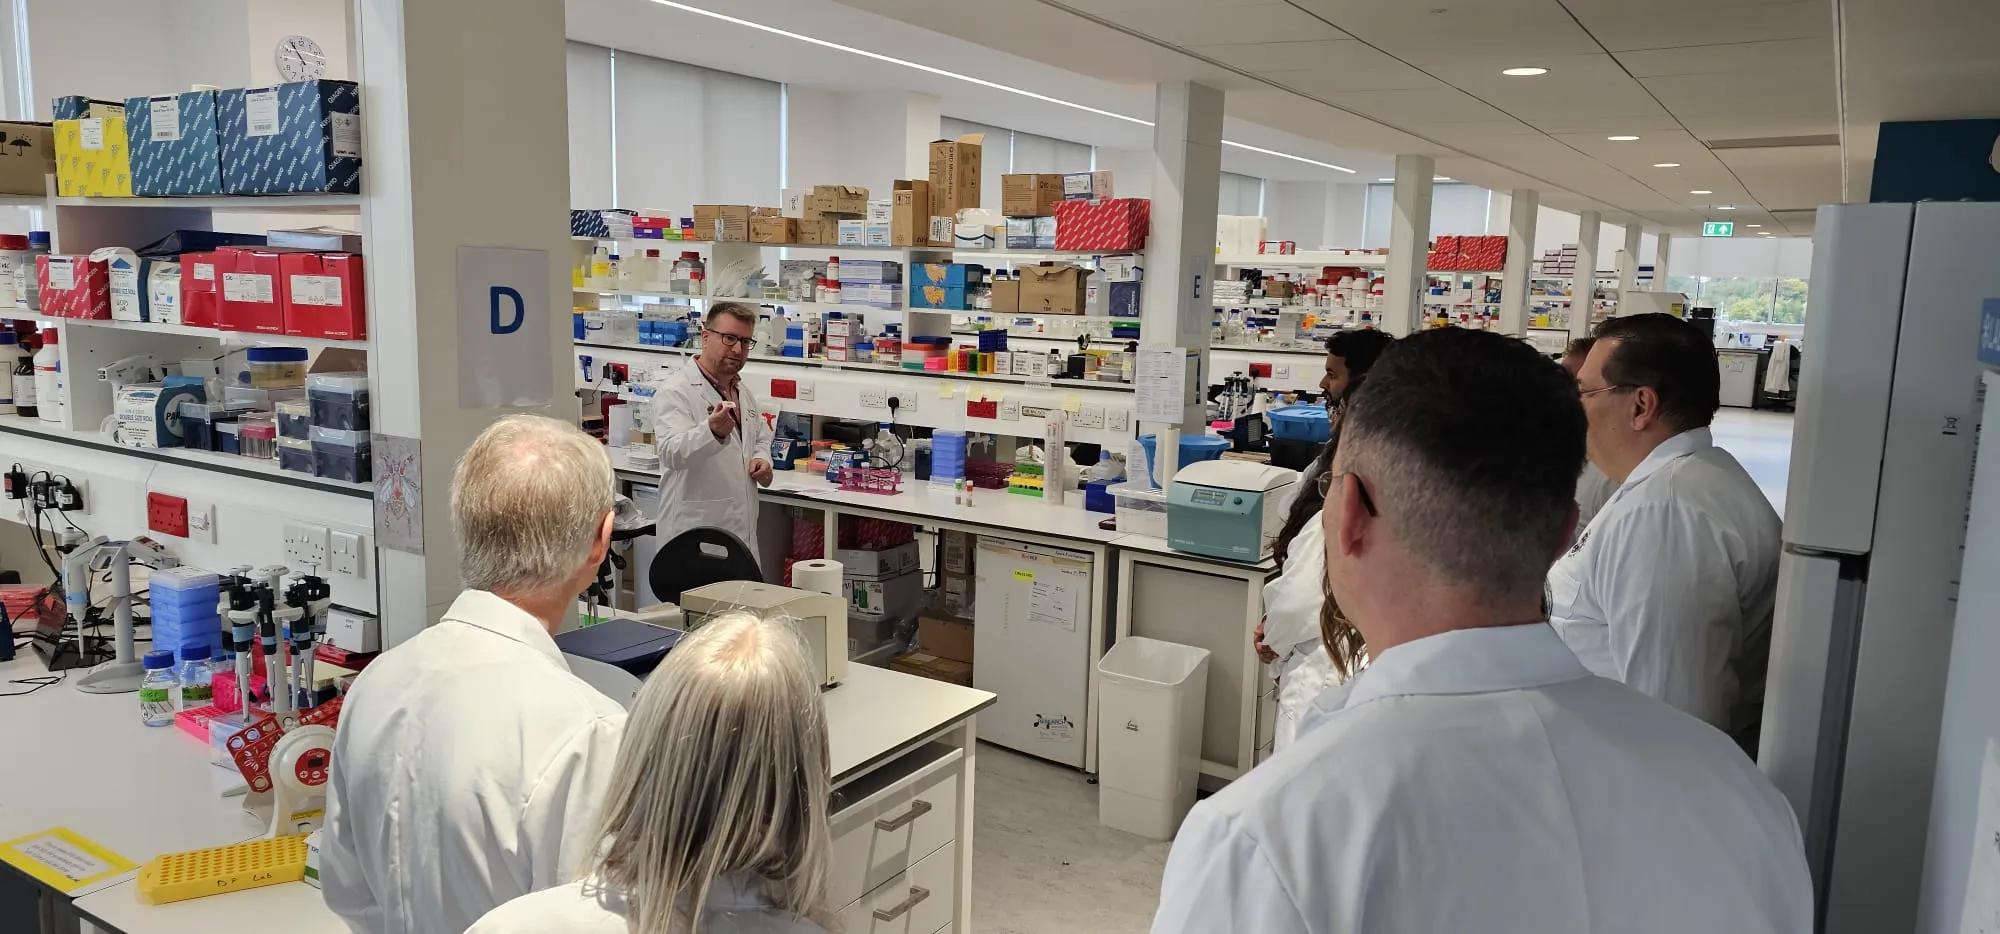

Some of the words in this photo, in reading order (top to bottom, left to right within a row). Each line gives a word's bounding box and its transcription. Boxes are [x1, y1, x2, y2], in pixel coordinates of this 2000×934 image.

[327, 86, 345, 104] QIAGEN
[1193, 275, 1201, 298] E
[491, 286, 524, 334] D
